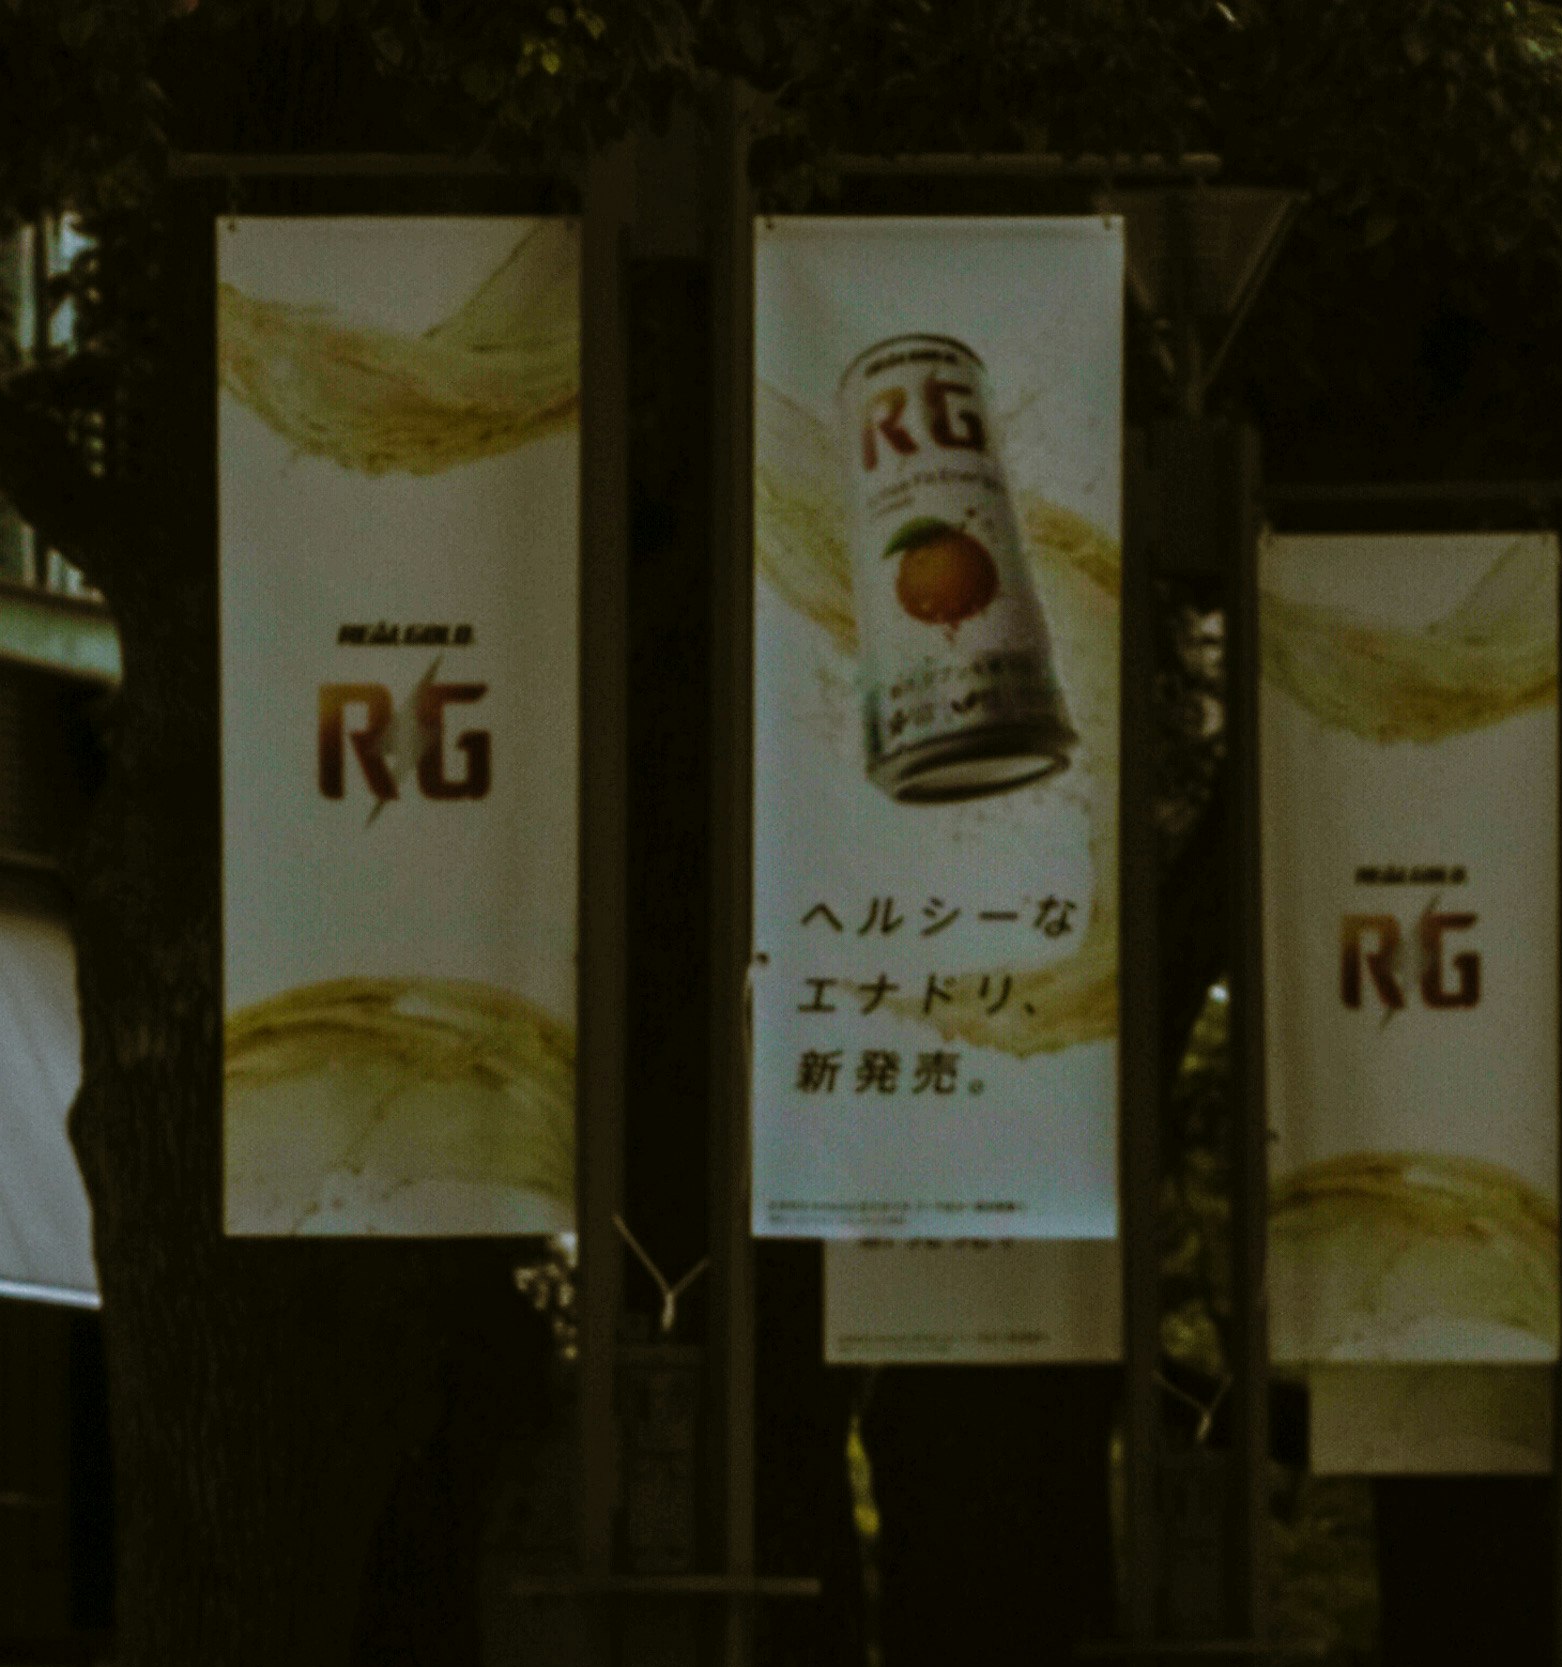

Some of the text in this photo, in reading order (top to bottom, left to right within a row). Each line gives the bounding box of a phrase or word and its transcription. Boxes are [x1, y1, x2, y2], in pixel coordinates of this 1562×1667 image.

[861, 378, 986, 471] RG
[318, 682, 491, 802] RG
[800, 895, 1077, 938] ヘルシーな
[798, 974, 1036, 1016] エナドリ、
[1340, 912, 1481, 1012] RG
[795, 1050, 985, 1095] 新発売。
